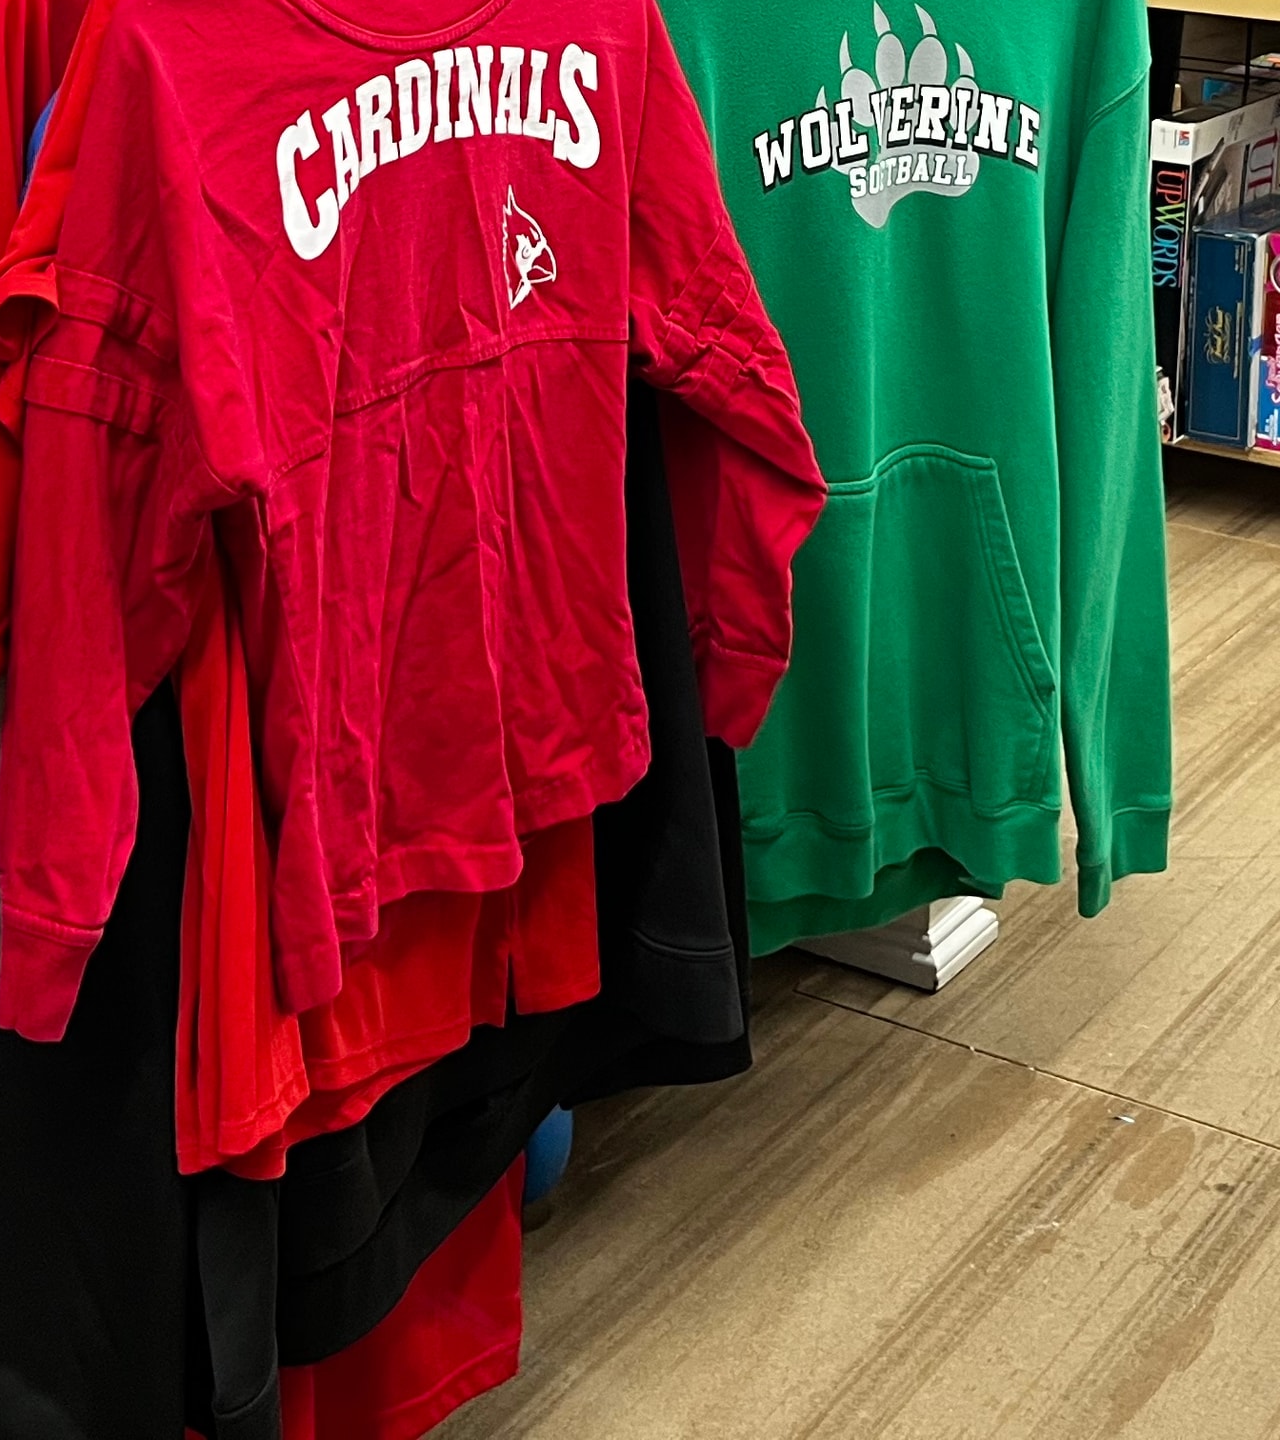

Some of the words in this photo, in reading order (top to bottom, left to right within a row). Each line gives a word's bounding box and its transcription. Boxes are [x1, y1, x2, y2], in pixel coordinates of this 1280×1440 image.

[275, 42, 601, 262] CARDINALS
[754, 83, 1042, 191] WOLVERINE
[849, 153, 975, 200] SOFTBALL
[1178, 129, 1191, 147] MB
[1153, 169, 1187, 289] UPWORDS
